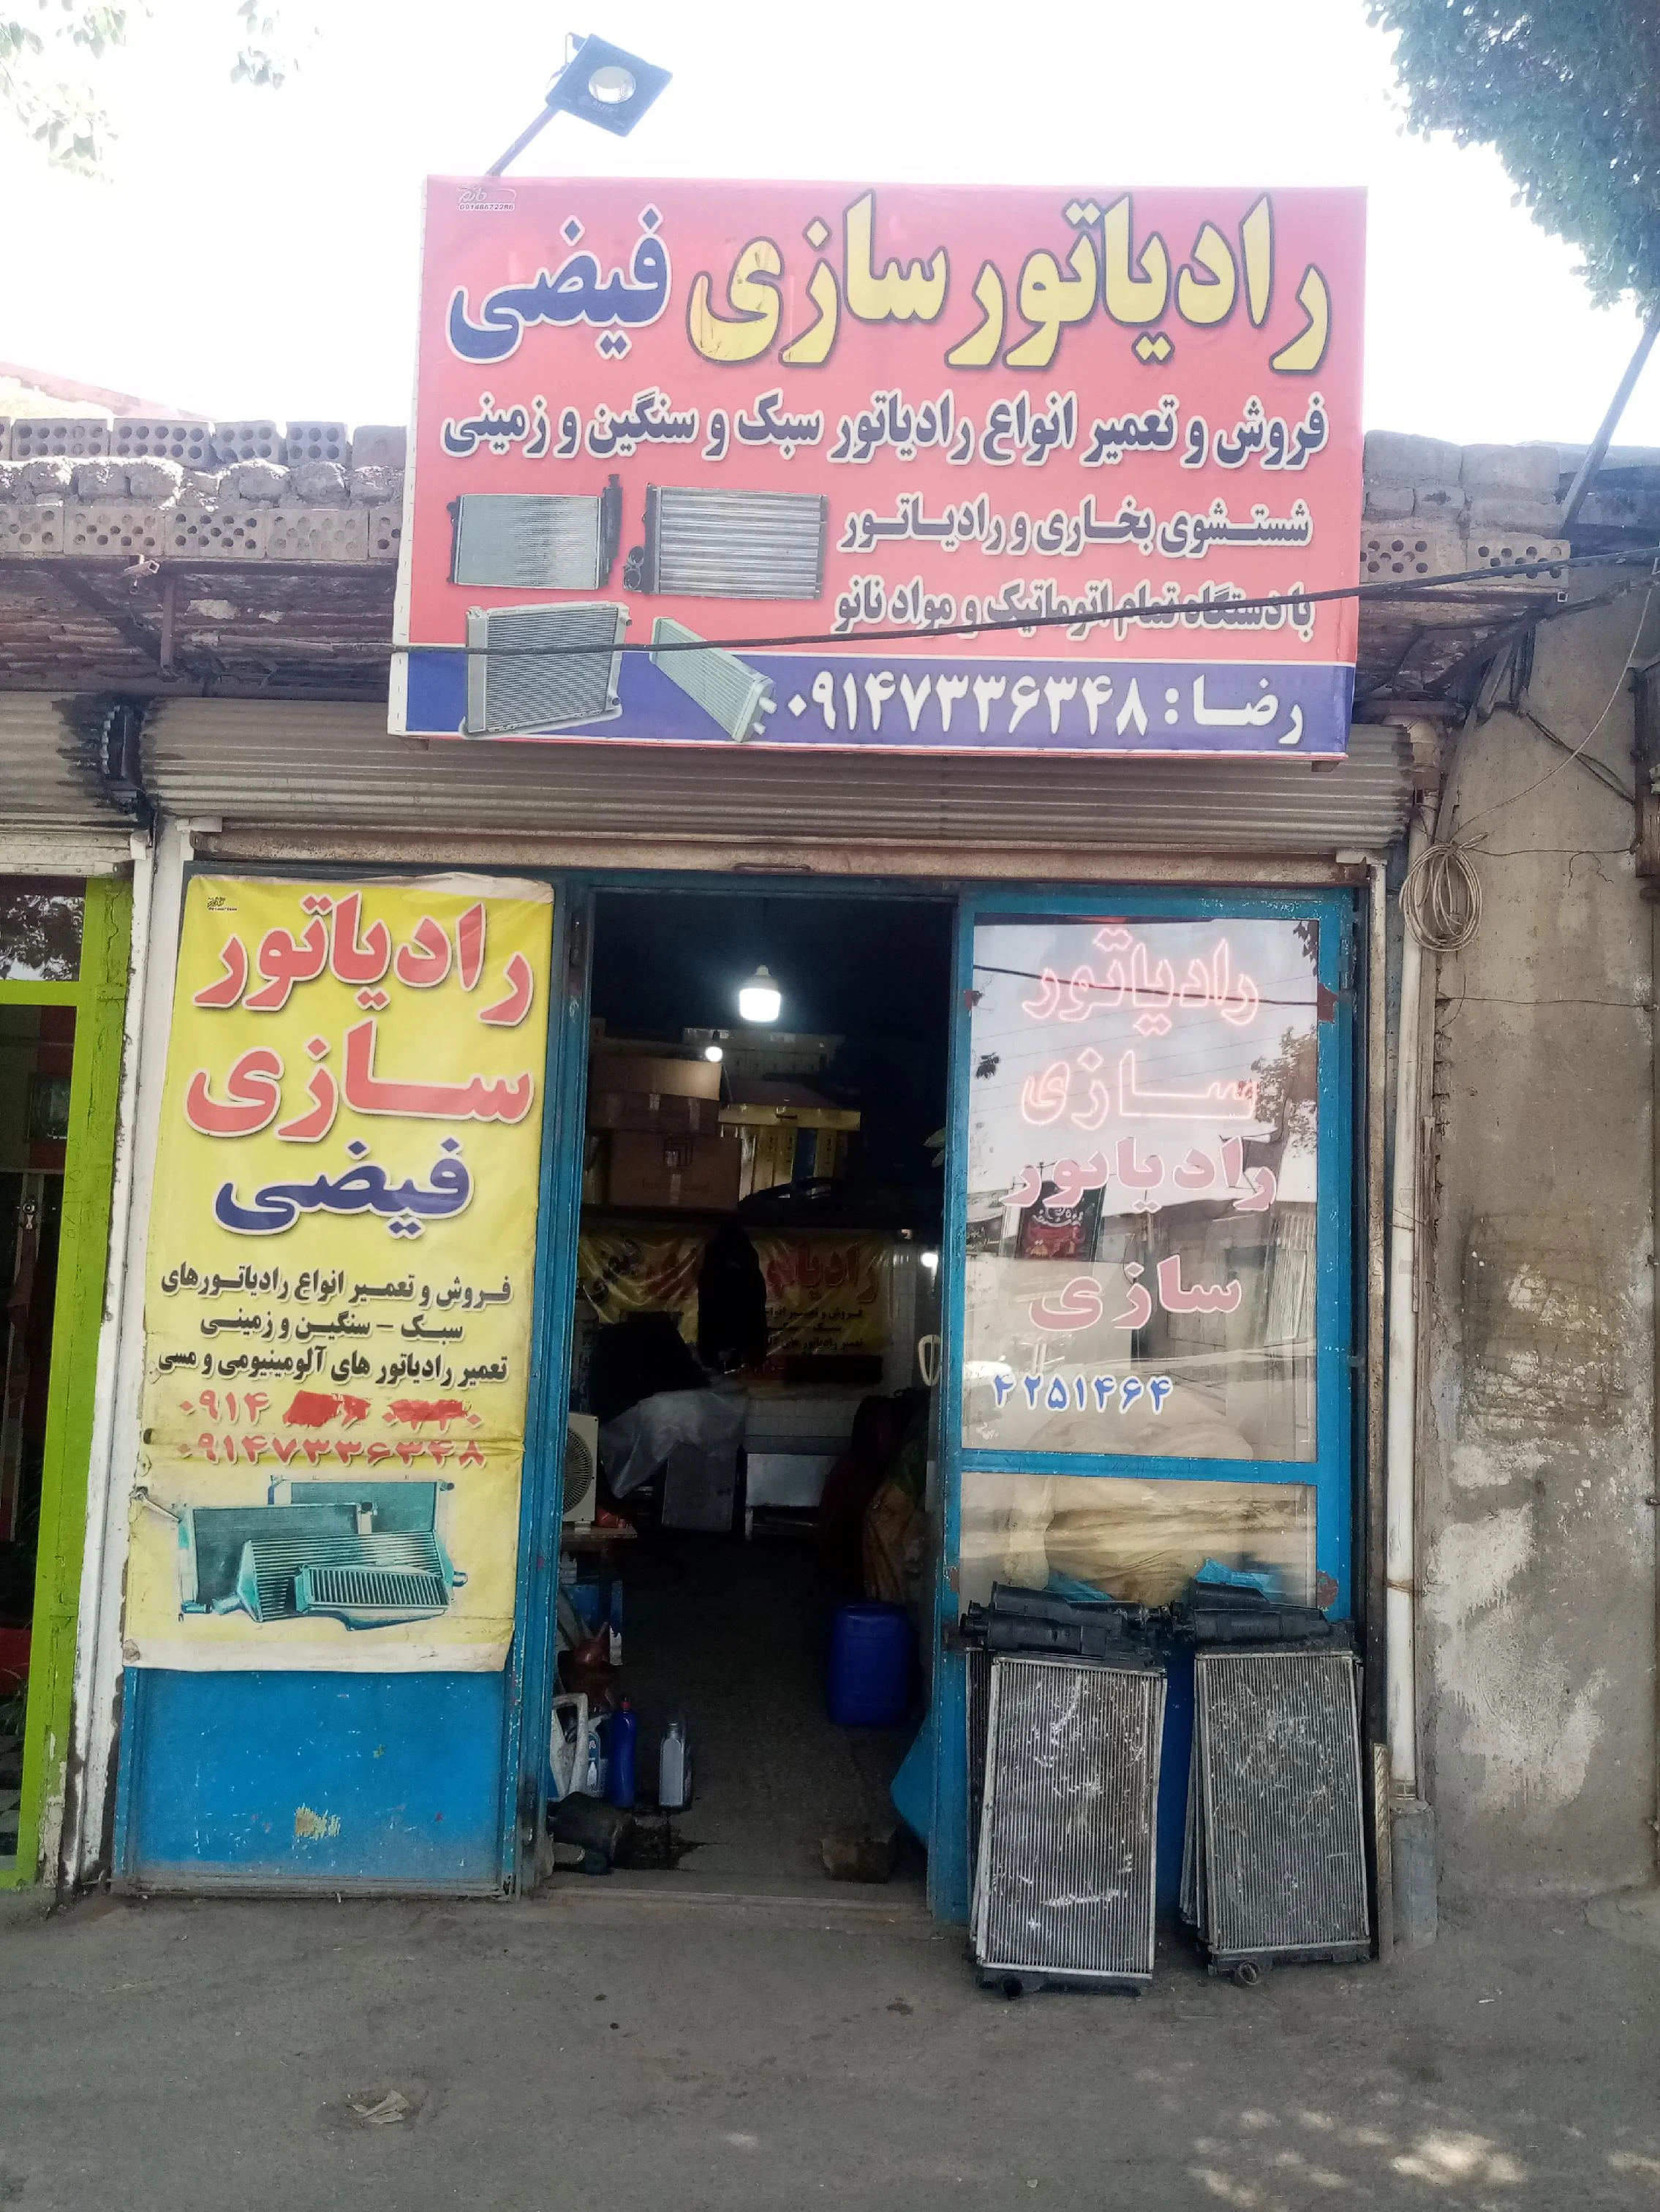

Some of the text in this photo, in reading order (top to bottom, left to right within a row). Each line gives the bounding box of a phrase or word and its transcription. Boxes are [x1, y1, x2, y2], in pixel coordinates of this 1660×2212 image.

[446, 188, 1332, 373] رادیاتور سازی فیضی
[440, 385, 1328, 470] فروش و تعمیر انواع رادیاتور سبک و سنگین و زمینی
[838, 492, 1313, 559] شستشوی بخاری و رادیاتور
[831, 574, 887, 635] نانو
[887, 575, 957, 638] مواد
[959, 594, 982, 639] و
[1112, 578, 1181, 641] تمام
[1182, 579, 1286, 630] دستگاه
[1287, 581, 1316, 642] با
[786, 669, 1150, 737] ۰۹۱۴۷۳۳۶۳۴۸
[192, 891, 535, 1027] رادیاتور
[1022, 928, 1261, 1037] رادیاتور
[185, 1015, 535, 1142] سازی
[1019, 1046, 1260, 1132] سازی
[213, 1136, 474, 1238] فیضی
[293, 1267, 345, 1302] انواع
[348, 1273, 415, 1305] تعمیر
[420, 1283, 433, 1308] و
[436, 1275, 513, 1312] فروش
[1028, 1253, 1243, 1332] سازی
[200, 1307, 274, 1337] زمینی
[278, 1317, 291, 1340] و
[295, 1311, 373, 1341] سنگین
[399, 1313, 465, 1343] سبک
[157, 1345, 510, 1391] تعمیر رادیاتور های آلومینیومی و مسی
[178, 1389, 270, 1424] ۰۹۱۴
[176, 1431, 488, 1471] ۰۹۱۴۷۳۳۶۳۴۸
